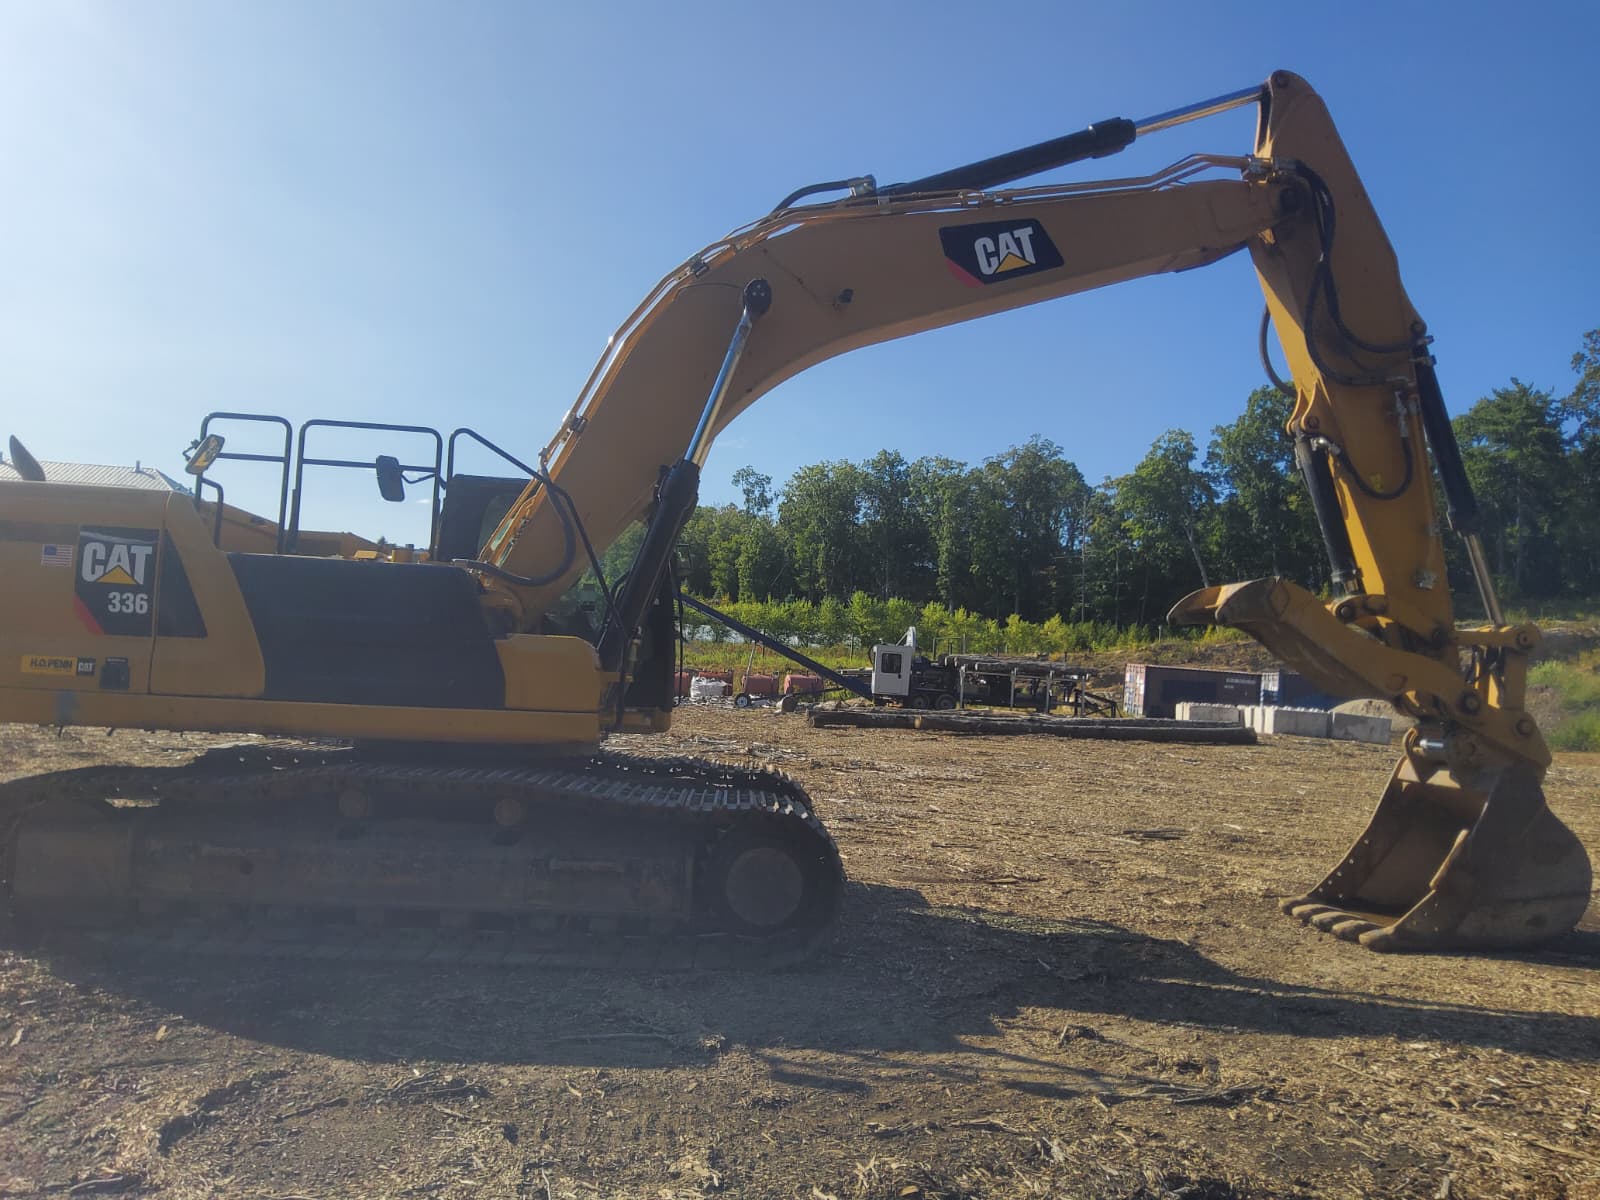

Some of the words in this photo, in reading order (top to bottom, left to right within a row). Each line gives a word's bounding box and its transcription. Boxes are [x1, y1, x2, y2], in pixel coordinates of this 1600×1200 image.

[974, 226, 1036, 275] CAT
[82, 542, 152, 585] CAT
[107, 592, 149, 614] 336
[77, 662, 93, 673] CAT
